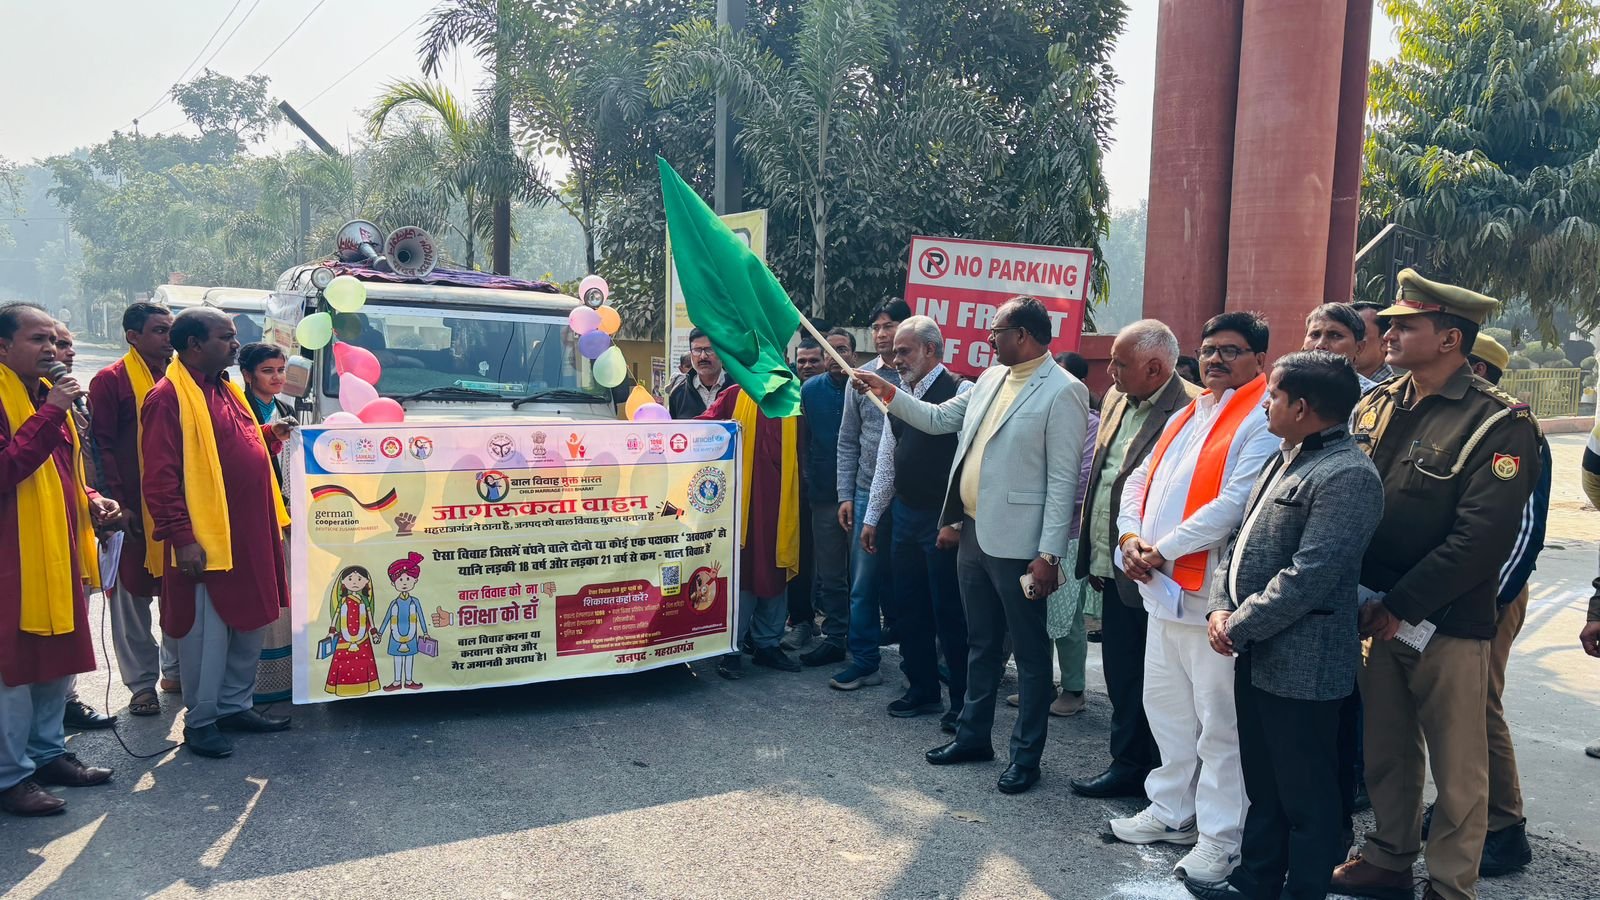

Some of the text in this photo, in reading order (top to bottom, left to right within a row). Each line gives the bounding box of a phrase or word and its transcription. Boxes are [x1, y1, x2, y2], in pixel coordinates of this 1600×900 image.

[954, 255, 1077, 286] NO PARKING
[916, 298, 1068, 338] IN FRT
[511, 478, 530, 486] बाल
[532, 476, 560, 486] विवाह
[561, 477, 579, 487] मुक्त
[315, 510, 352, 519] german
[432, 495, 648, 521] जागरूकता वाहन
[424, 523, 472, 534] महराजगंज
[473, 522, 480, 531] ने
[482, 523, 502, 531] ठाना
[515, 521, 541, 529] जनपद
[542, 518, 555, 526] को
[574, 516, 599, 524] विवाह
[622, 514, 647, 522] बनाना
[647, 512, 655, 521] है
[432, 549, 455, 561] ऐसा
[458, 548, 487, 560] विवाह
[490, 544, 521, 558] जिसमें
[547, 541, 568, 553] वाले
[595, 541, 606, 550] या
[609, 536, 629, 549] कोई
[630, 537, 646, 547] एक
[648, 534, 679, 546] पक्षकार
[718, 527, 727, 538] हो
[458, 564, 483, 576] यानि
[486, 561, 516, 576] लड़की
[519, 562, 528, 572] 18
[531, 558, 547, 570] वर्ष
[550, 557, 568, 569] और
[570, 556, 598, 568] लड़का
[601, 555, 610, 565] 21
[614, 552, 629, 564] वर्ष
[629, 551, 637, 562] से
[640, 551, 656, 561] कम
[664, 548, 684, 559] बाल
[685, 546, 705, 557] विवाह
[458, 583, 538, 600] बाल विवाह को ना
[584, 592, 649, 606] शिकायत कहां करें?
[457, 596, 539, 626] शिक्षा को हाँ
[458, 637, 476, 646] बाल
[479, 635, 504, 644] विवाह
[506, 632, 528, 641] करना
[461, 648, 493, 658] करवाना
[521, 641, 538, 651] और
[615, 652, 647, 663] जनपद
[654, 640, 694, 657] महराजगंज
[467, 657, 502, 669] जमानती
